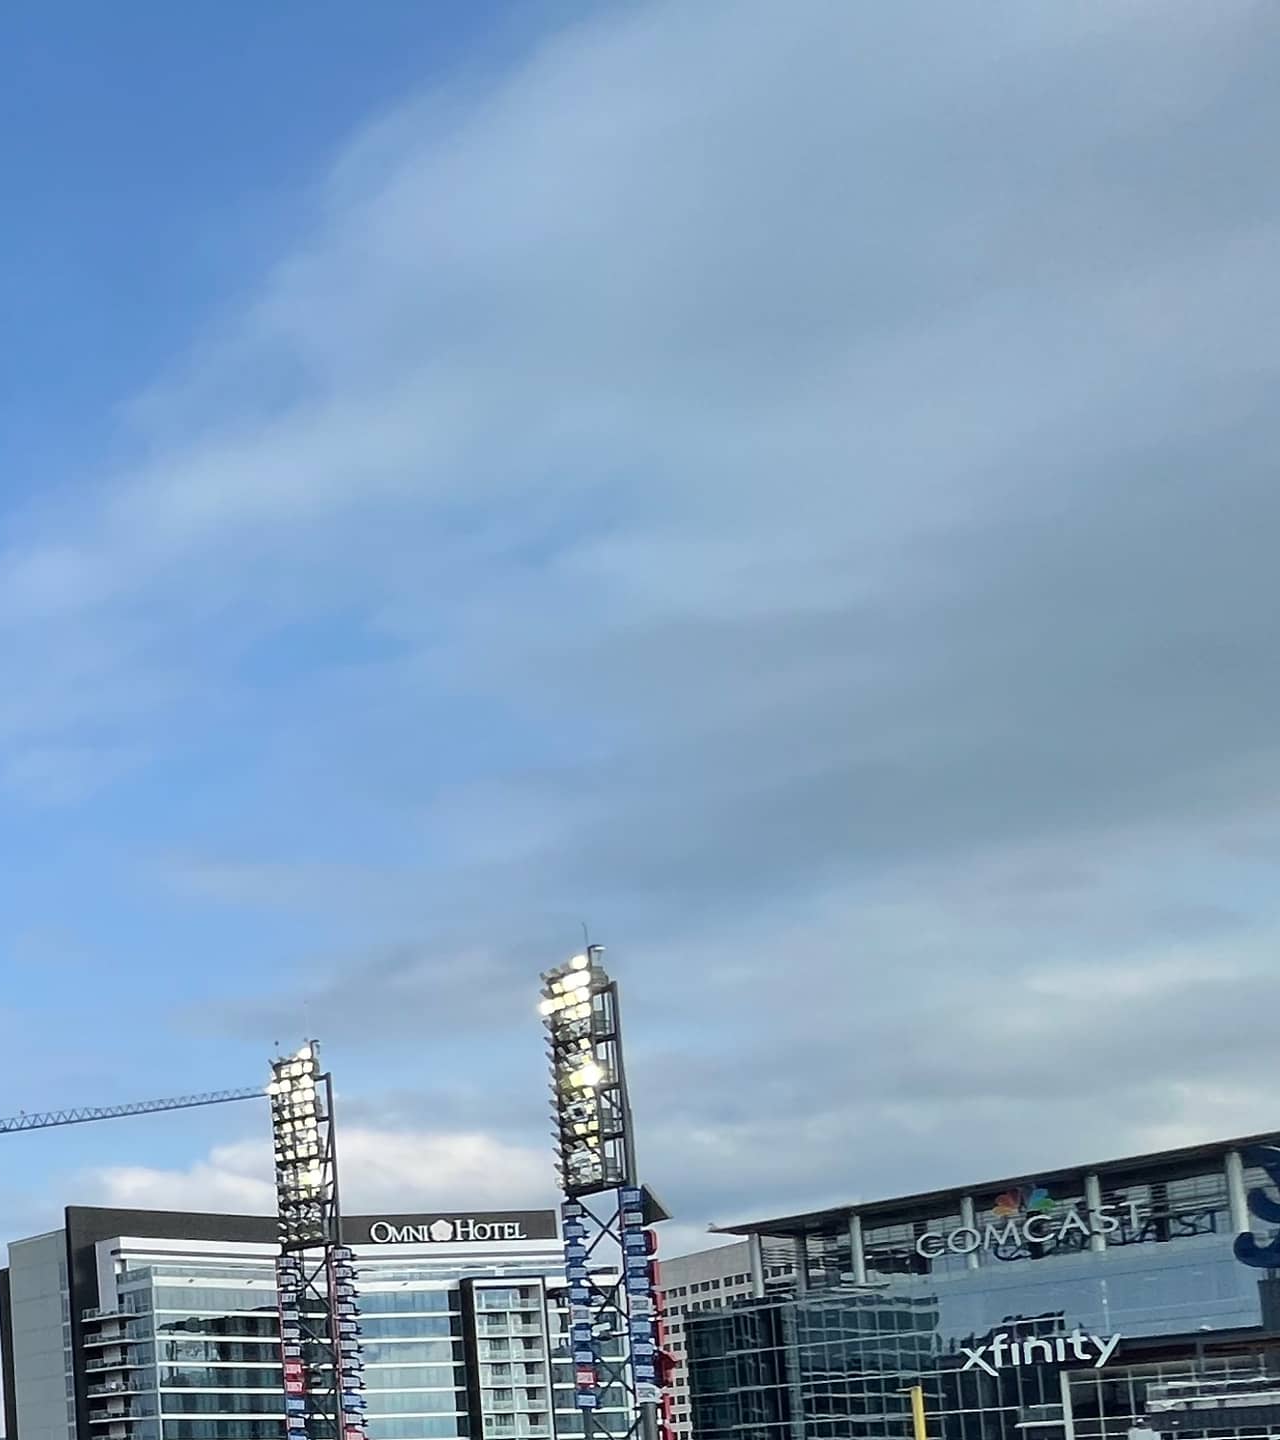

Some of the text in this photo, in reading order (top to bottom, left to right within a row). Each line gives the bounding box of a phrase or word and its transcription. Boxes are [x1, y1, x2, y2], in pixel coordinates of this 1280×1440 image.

[370, 1219, 527, 1243] OMNI HOTEL
[916, 1201, 1144, 1259] COMCAST
[959, 1328, 1122, 1377] xfinity
